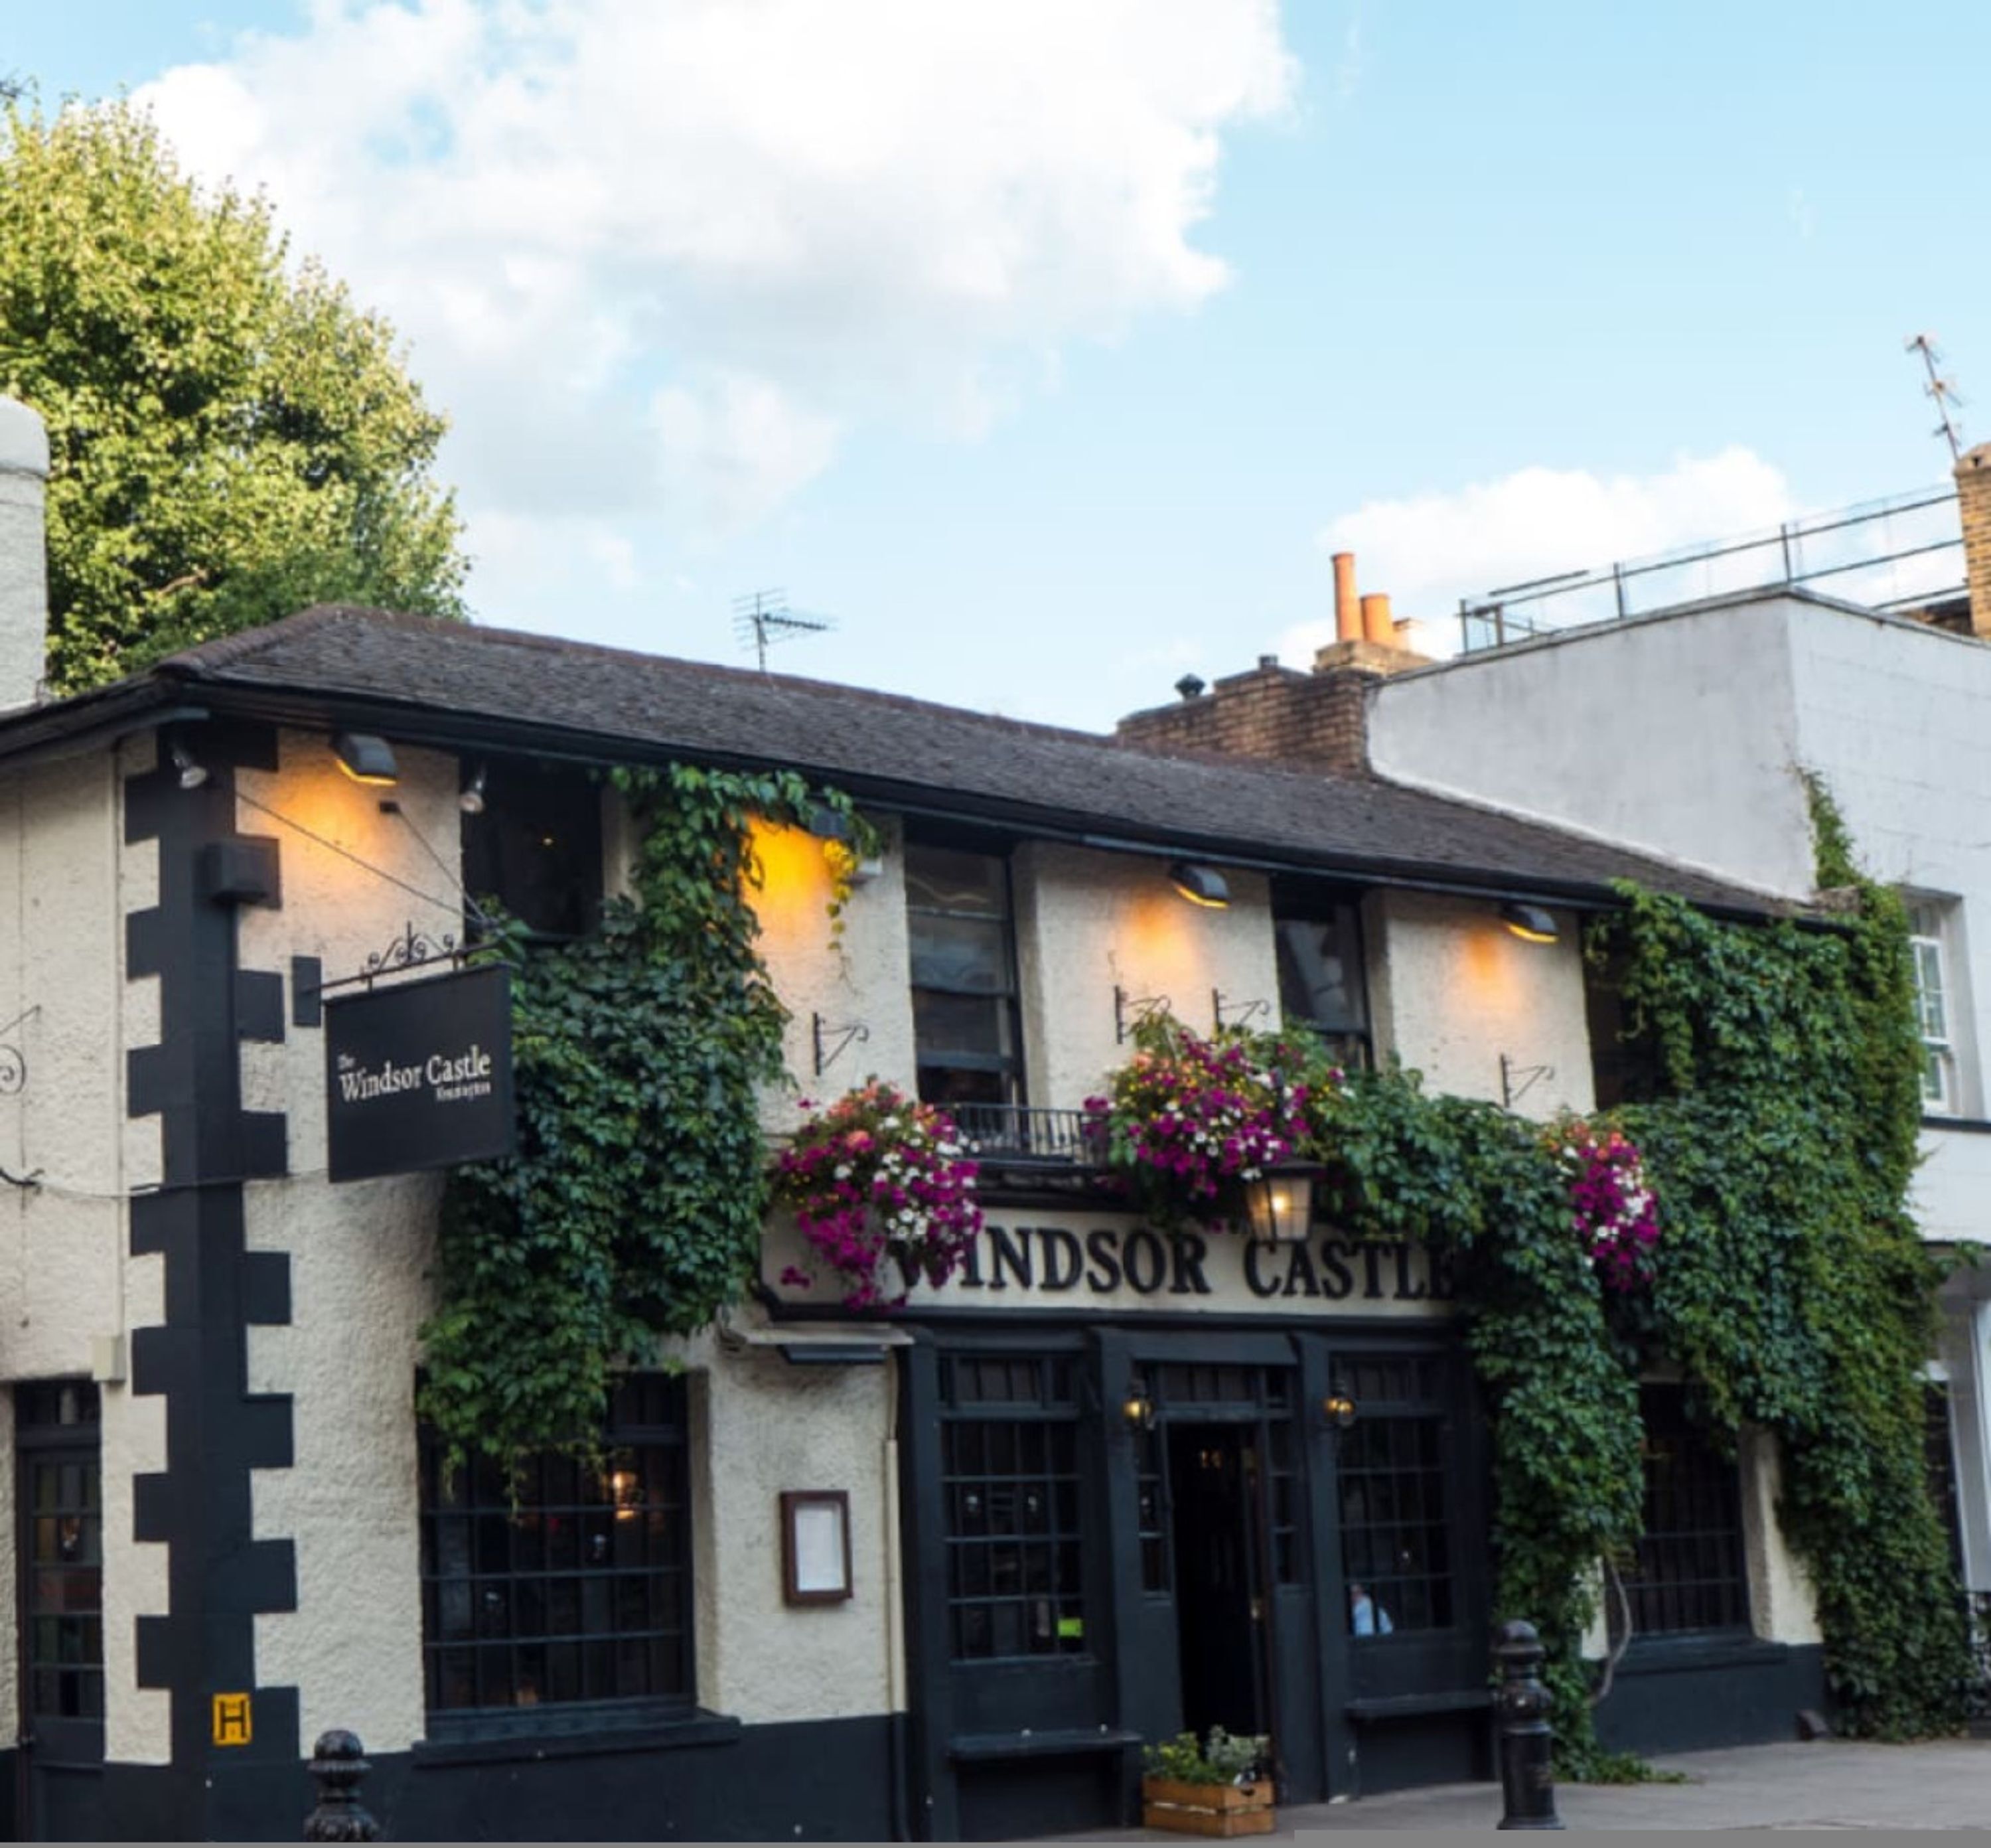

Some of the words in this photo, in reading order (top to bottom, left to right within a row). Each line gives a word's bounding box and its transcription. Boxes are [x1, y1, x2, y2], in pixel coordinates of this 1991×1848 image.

[339, 1059, 423, 1102] Windsor
[426, 1044, 491, 1085] Castle
[218, 1699, 246, 1740] H
